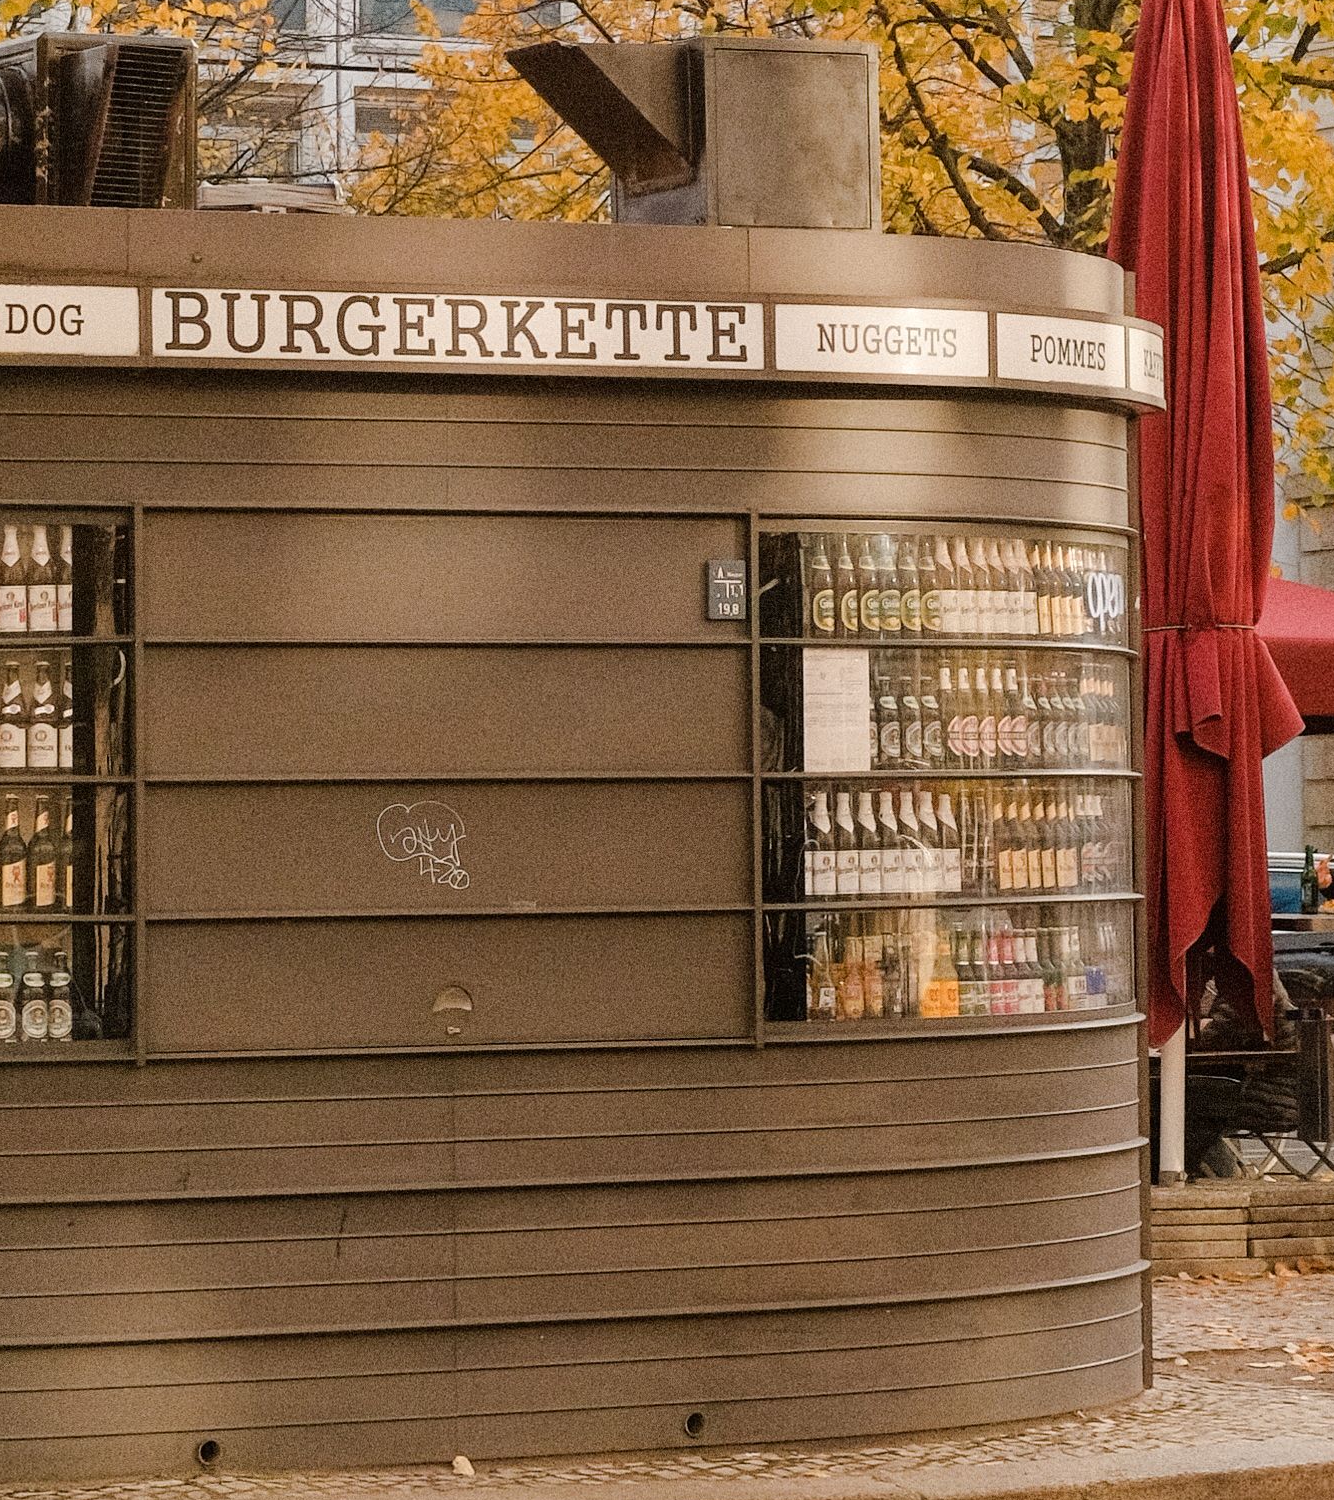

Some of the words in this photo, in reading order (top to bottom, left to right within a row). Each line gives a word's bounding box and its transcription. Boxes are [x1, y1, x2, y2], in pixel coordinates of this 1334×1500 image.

[4, 303, 85, 337] DOG
[164, 290, 748, 363] BURGERKETTE
[816, 323, 958, 359] NUGGETS
[1030, 333, 1107, 372] POMMES
[718, 602, 740, 617] 19,8
